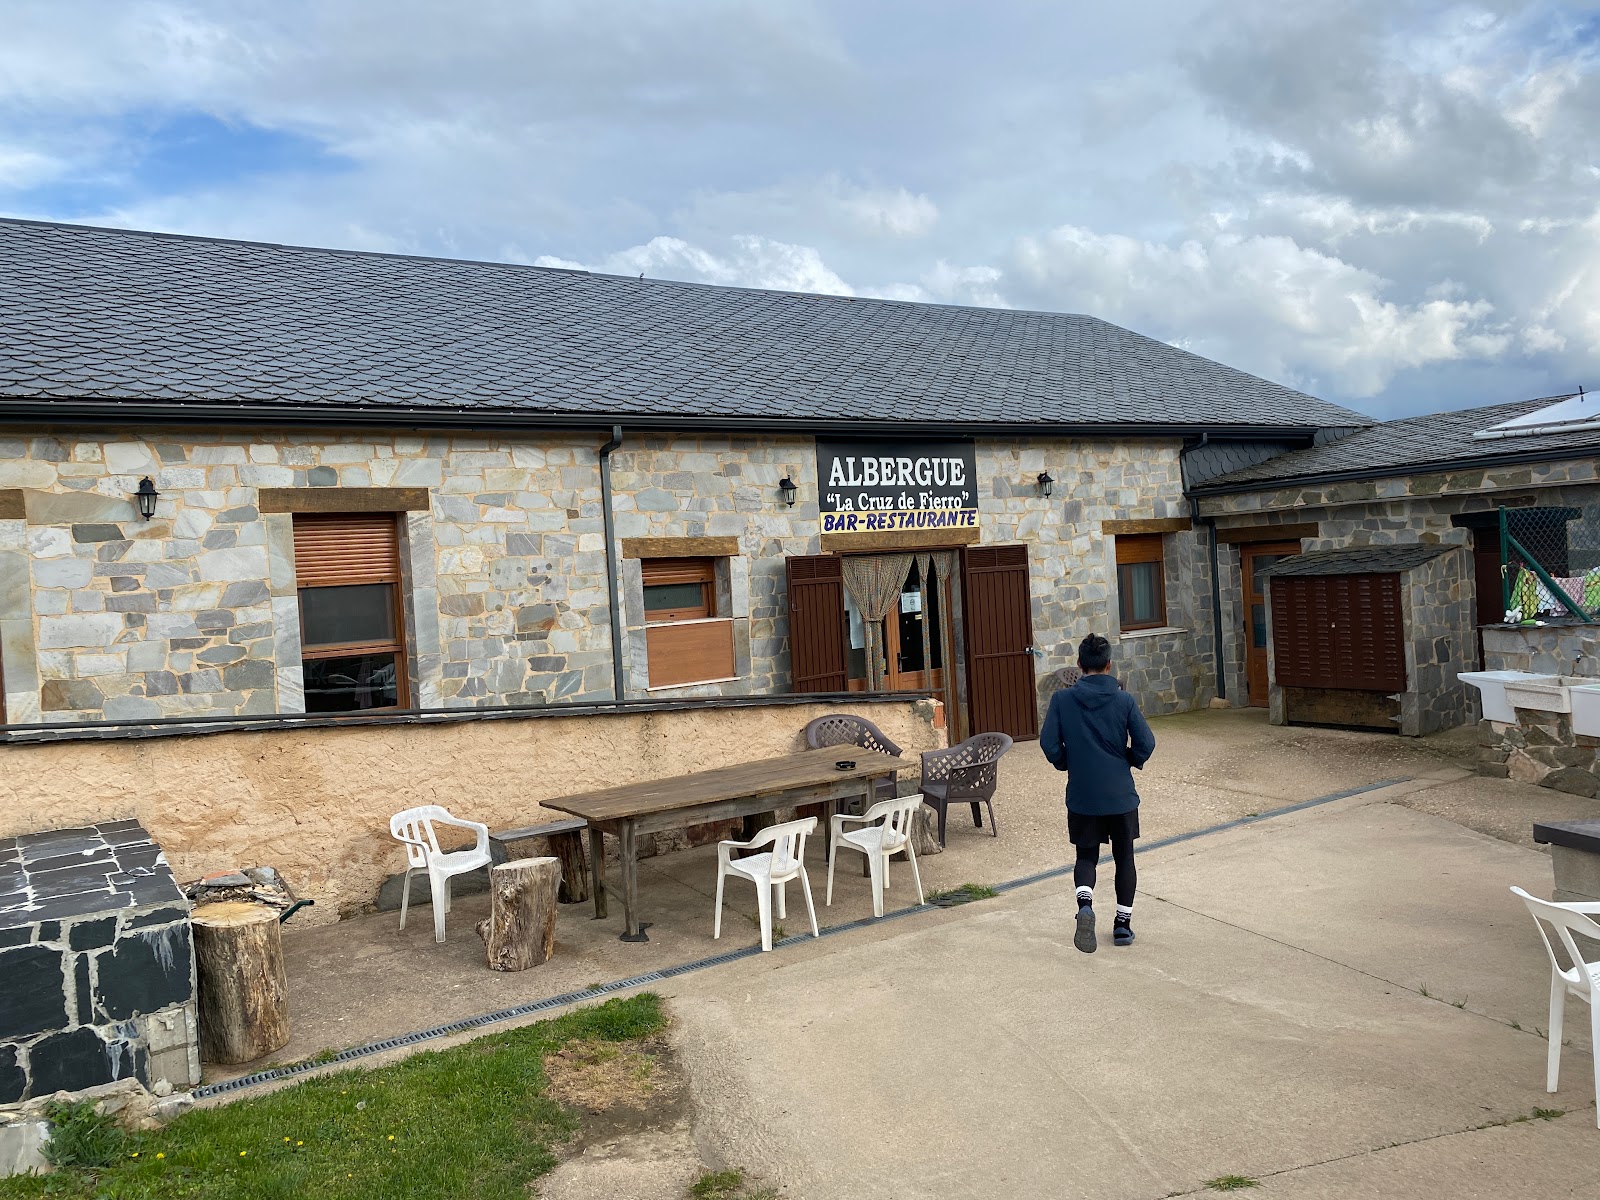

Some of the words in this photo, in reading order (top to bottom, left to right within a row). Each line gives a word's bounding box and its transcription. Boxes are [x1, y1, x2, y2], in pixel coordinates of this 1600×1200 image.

[828, 456, 966, 487] ALBERGUE
[857, 492, 894, 511] Cruz
[897, 490, 915, 510] de
[823, 509, 977, 532] BAR-RESTAURANTE
